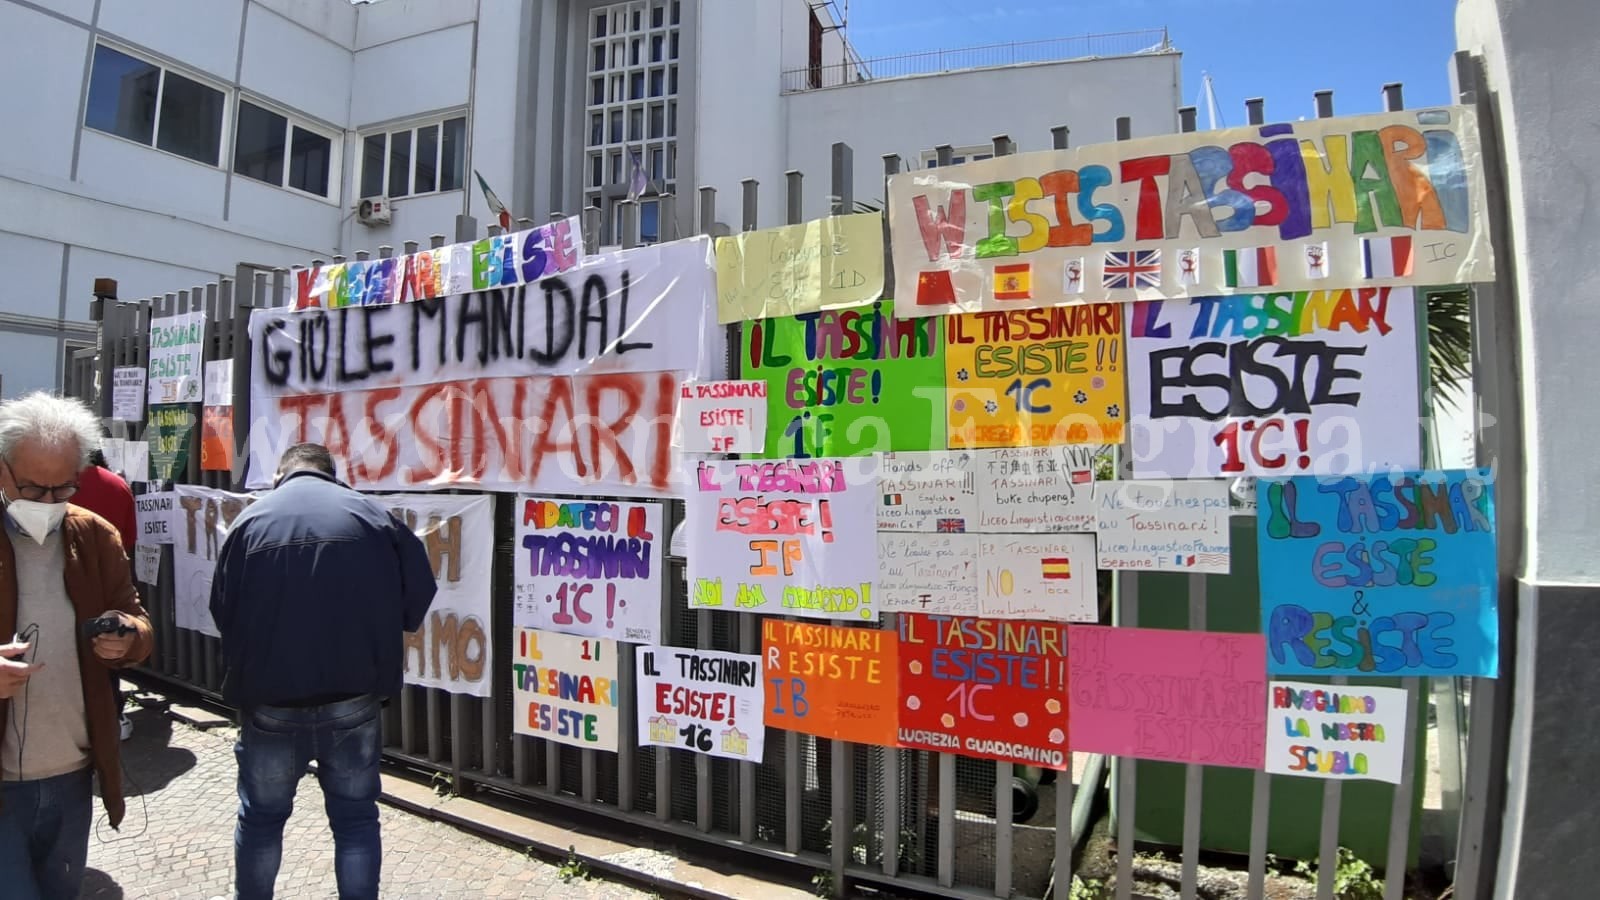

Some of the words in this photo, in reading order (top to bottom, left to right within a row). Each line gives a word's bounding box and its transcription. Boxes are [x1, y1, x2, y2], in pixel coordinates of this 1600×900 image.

[337, 303, 396, 382] LE
[412, 284, 526, 370] MANI
[530, 270, 653, 366] DAL
[949, 313, 975, 344] IL
[974, 303, 1121, 343] TASSINARI
[1131, 299, 1171, 338] IL
[1189, 286, 1393, 339] TASSINARI
[1149, 335, 1367, 421] ESISTE
[278, 371, 677, 493] TASSINARI
[883, 459, 922, 473] Hands
[932, 457, 954, 473] off
[136, 498, 174, 513] TASSINARI
[1203, 496, 1228, 514] pas
[1267, 480, 1321, 540] IL
[144, 520, 168, 535] ESISTE
[1158, 556, 1168, 569] F
[986, 566, 1014, 598] NO
[1351, 589, 1372, 617] &
[520, 631, 543, 661] IL
[765, 621, 777, 642] IL
[783, 622, 880, 653] TASSINARI
[899, 613, 924, 643] IL
[928, 615, 1067, 657] TASSINARI
[513, 663, 618, 707] TASSINARI
[643, 652, 661, 676] IL
[675, 653, 757, 688] TASSINARI
[946, 682, 995, 721] 1C
[528, 702, 599, 742] ESISTE
[1284, 716, 1311, 738] LA
[1321, 722, 1386, 743] NOSTRA
[898, 727, 961, 749] LUCREZIA
[965, 736, 1064, 766] GUADAGNINO
[1287, 744, 1369, 776] SCUOLA
